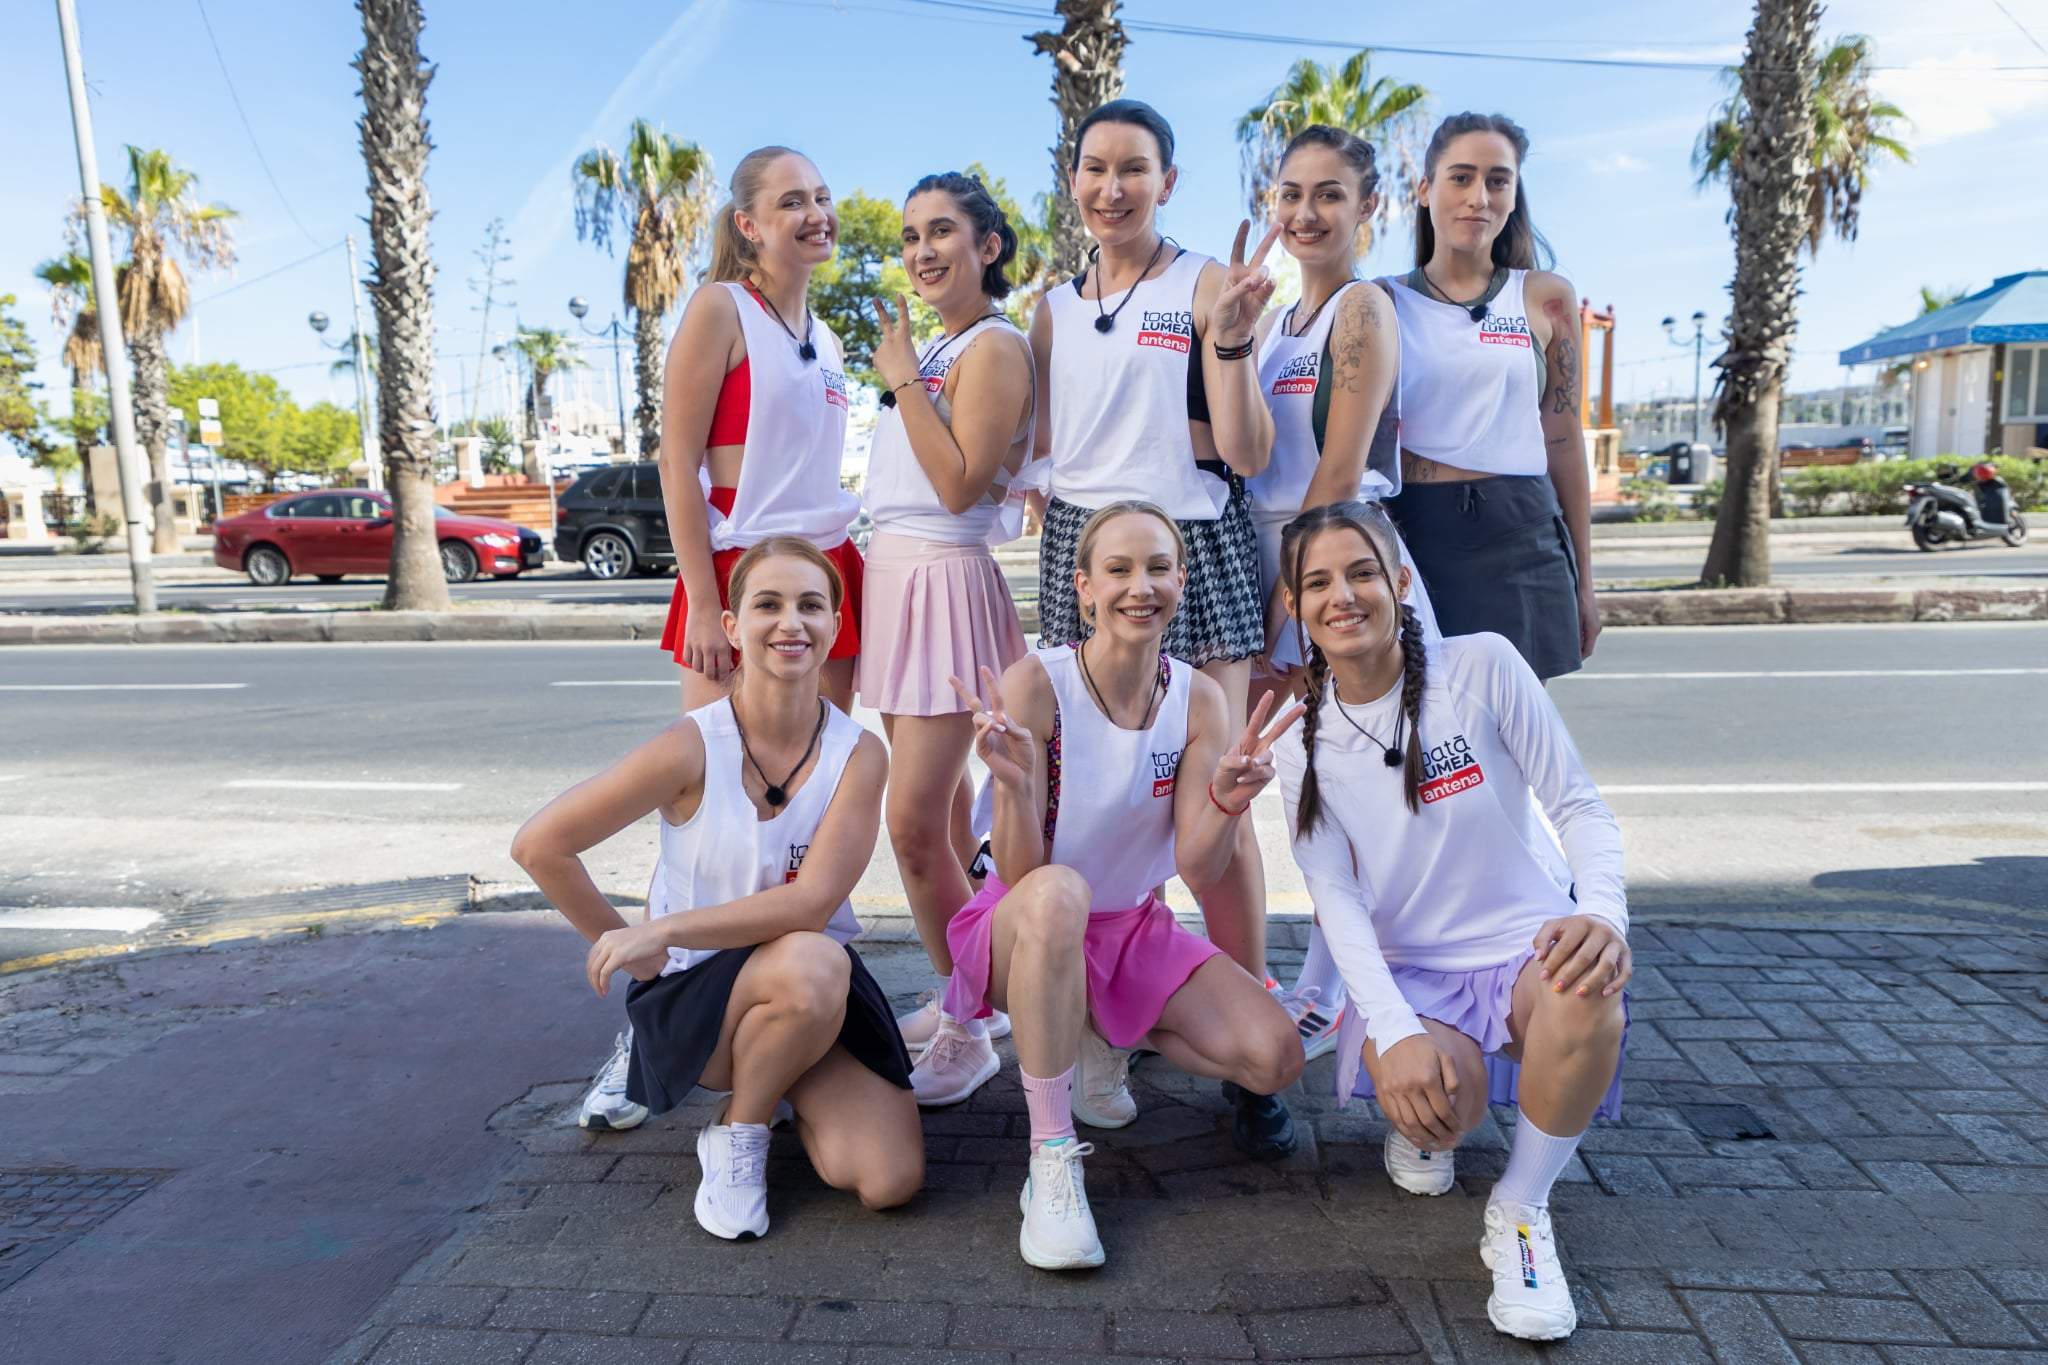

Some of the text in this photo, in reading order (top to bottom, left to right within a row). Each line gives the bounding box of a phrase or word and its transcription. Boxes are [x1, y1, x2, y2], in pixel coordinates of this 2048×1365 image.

[1141, 322, 1190, 336] LUMEA
[1481, 322, 1528, 334] LUMEA
[1140, 335, 1187, 351] antena
[1482, 335, 1529, 347] antena
[1278, 367, 1316, 379] LUMEA
[1274, 383, 1313, 394] antena
[1423, 753, 1475, 780] UMEA
[1423, 772, 1481, 801] antena
